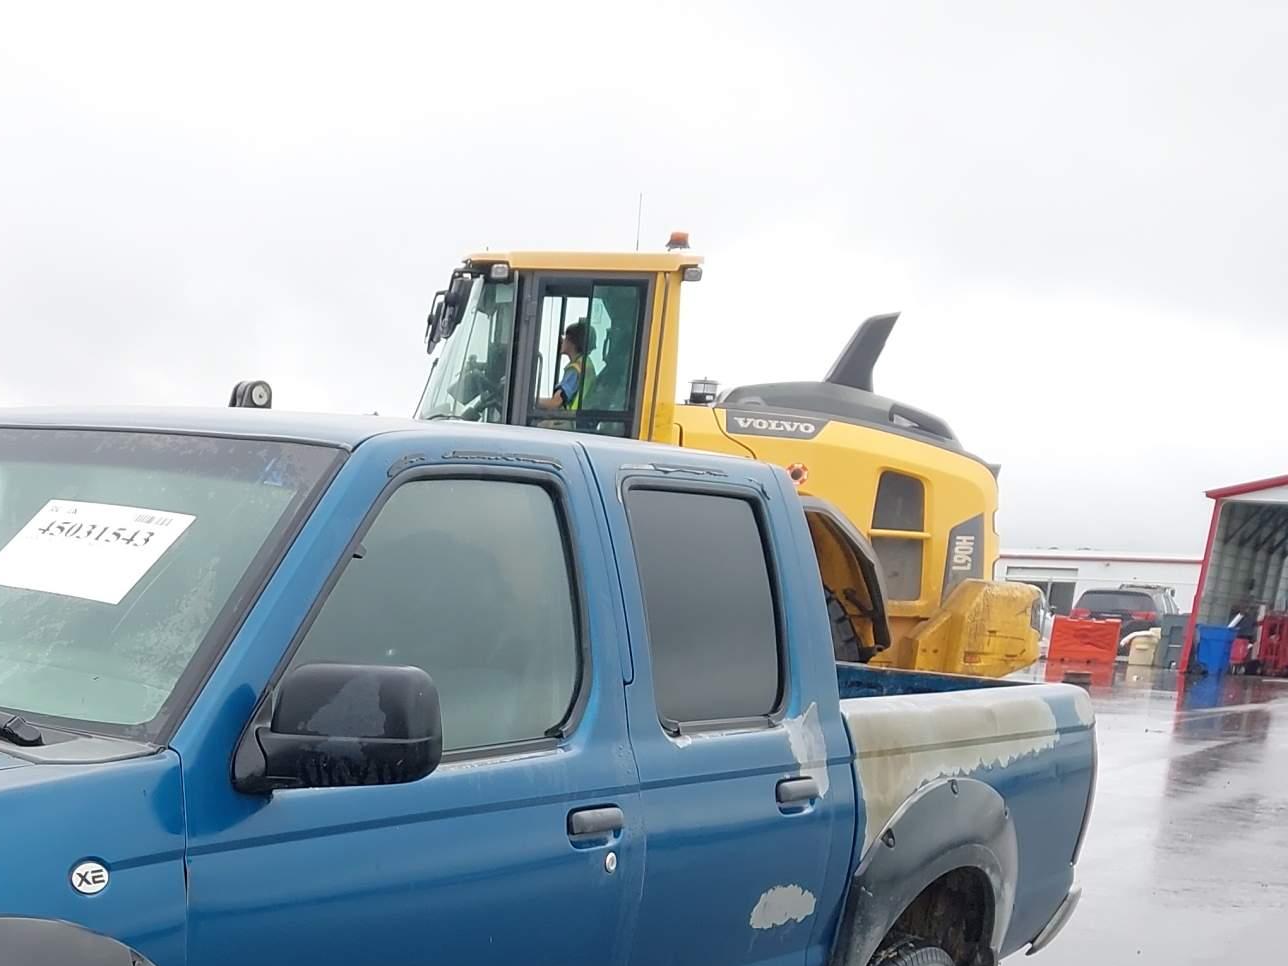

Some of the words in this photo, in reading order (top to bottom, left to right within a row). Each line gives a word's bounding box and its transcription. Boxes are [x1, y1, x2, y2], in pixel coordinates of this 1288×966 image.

[733, 416, 816, 434] VOLVO
[38, 520, 155, 547] 45031543
[951, 535, 975, 571] L90H
[75, 868, 106, 888] XE
